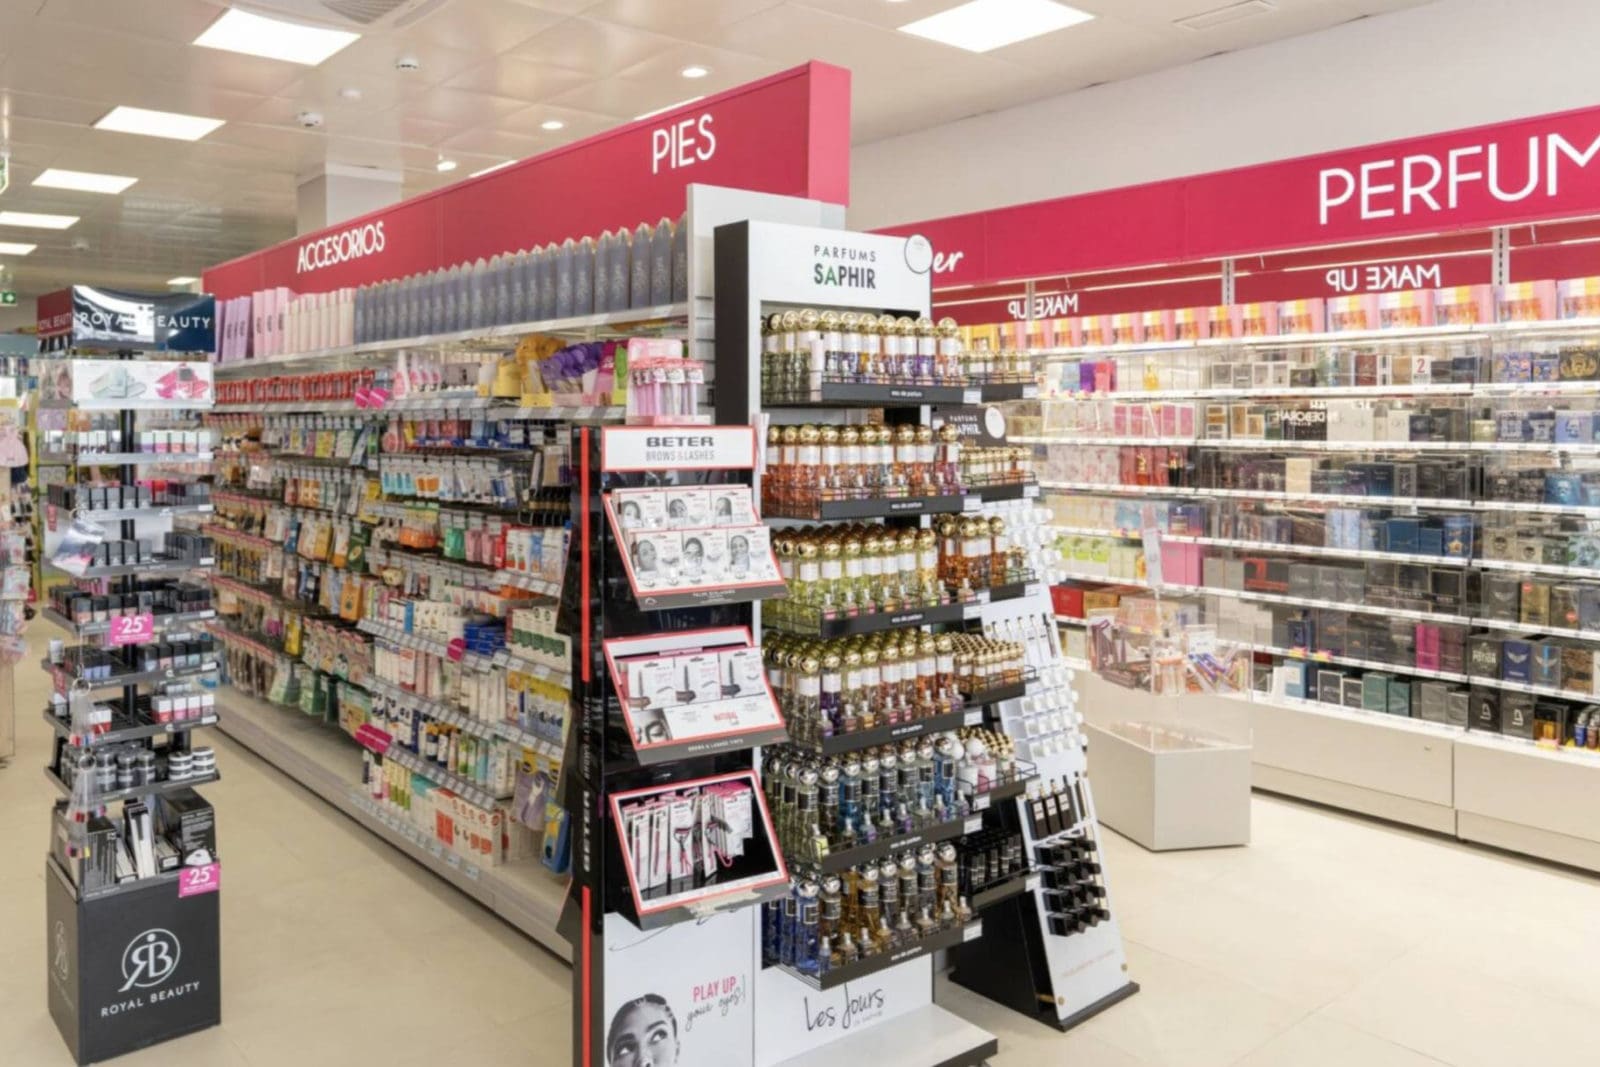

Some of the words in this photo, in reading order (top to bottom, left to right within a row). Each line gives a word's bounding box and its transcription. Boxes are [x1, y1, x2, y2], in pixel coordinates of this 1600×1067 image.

[652, 113, 717, 175] PIES
[296, 219, 386, 275] ACCESORIOS
[813, 244, 877, 263] PARFUMS
[932, 250, 965, 273] er
[813, 263, 877, 289] SAPHIR
[149, 315, 212, 329] EAUTY
[646, 436, 715, 448] BETER
[645, 451, 676, 462] BROWS
[684, 450, 715, 461] LASHES
[100, 998, 145, 1018] ROYAL
[149, 981, 200, 1004] BEAUTY
[692, 981, 720, 1004] PLAY
[722, 975, 737, 995] UP
[685, 1002, 714, 1033] your
[803, 995, 836, 1033] Les
[842, 982, 885, 1030] Jours
